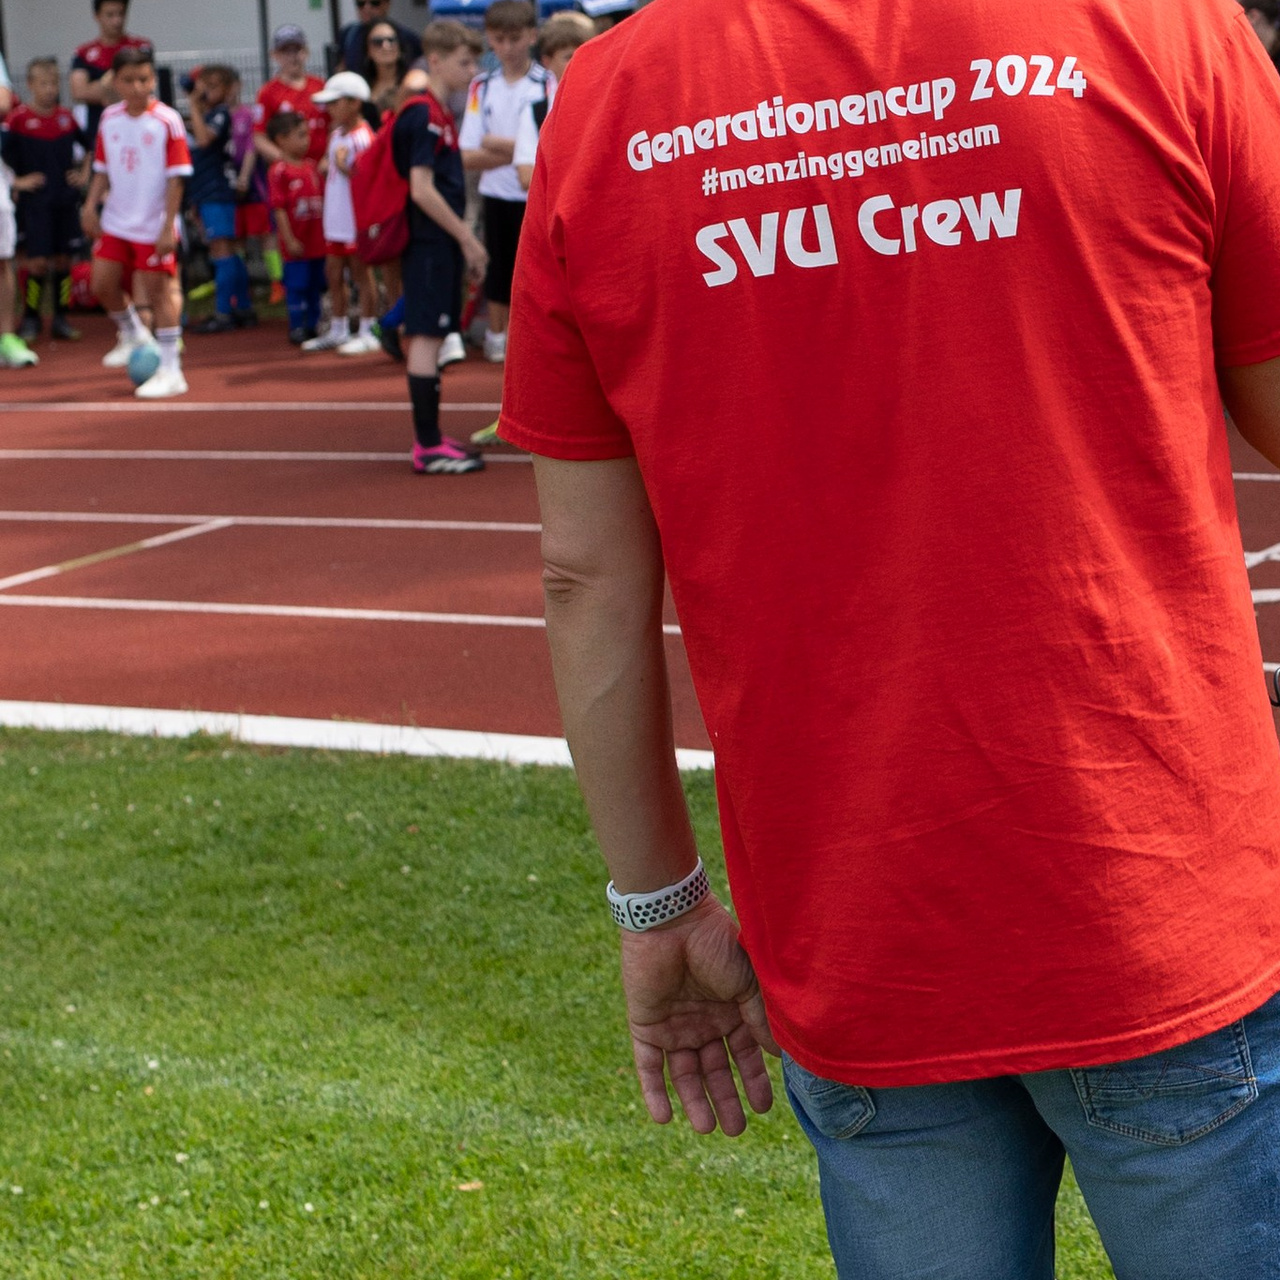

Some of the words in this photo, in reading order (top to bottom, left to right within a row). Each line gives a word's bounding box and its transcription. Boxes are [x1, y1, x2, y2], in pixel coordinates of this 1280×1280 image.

[627, 77, 956, 172] Generationencup
[969, 55, 1087, 102] 2024
[701, 124, 1000, 196] #menzinggemeinsam
[695, 204, 839, 287] SVU
[857, 188, 1023, 256] Crew
